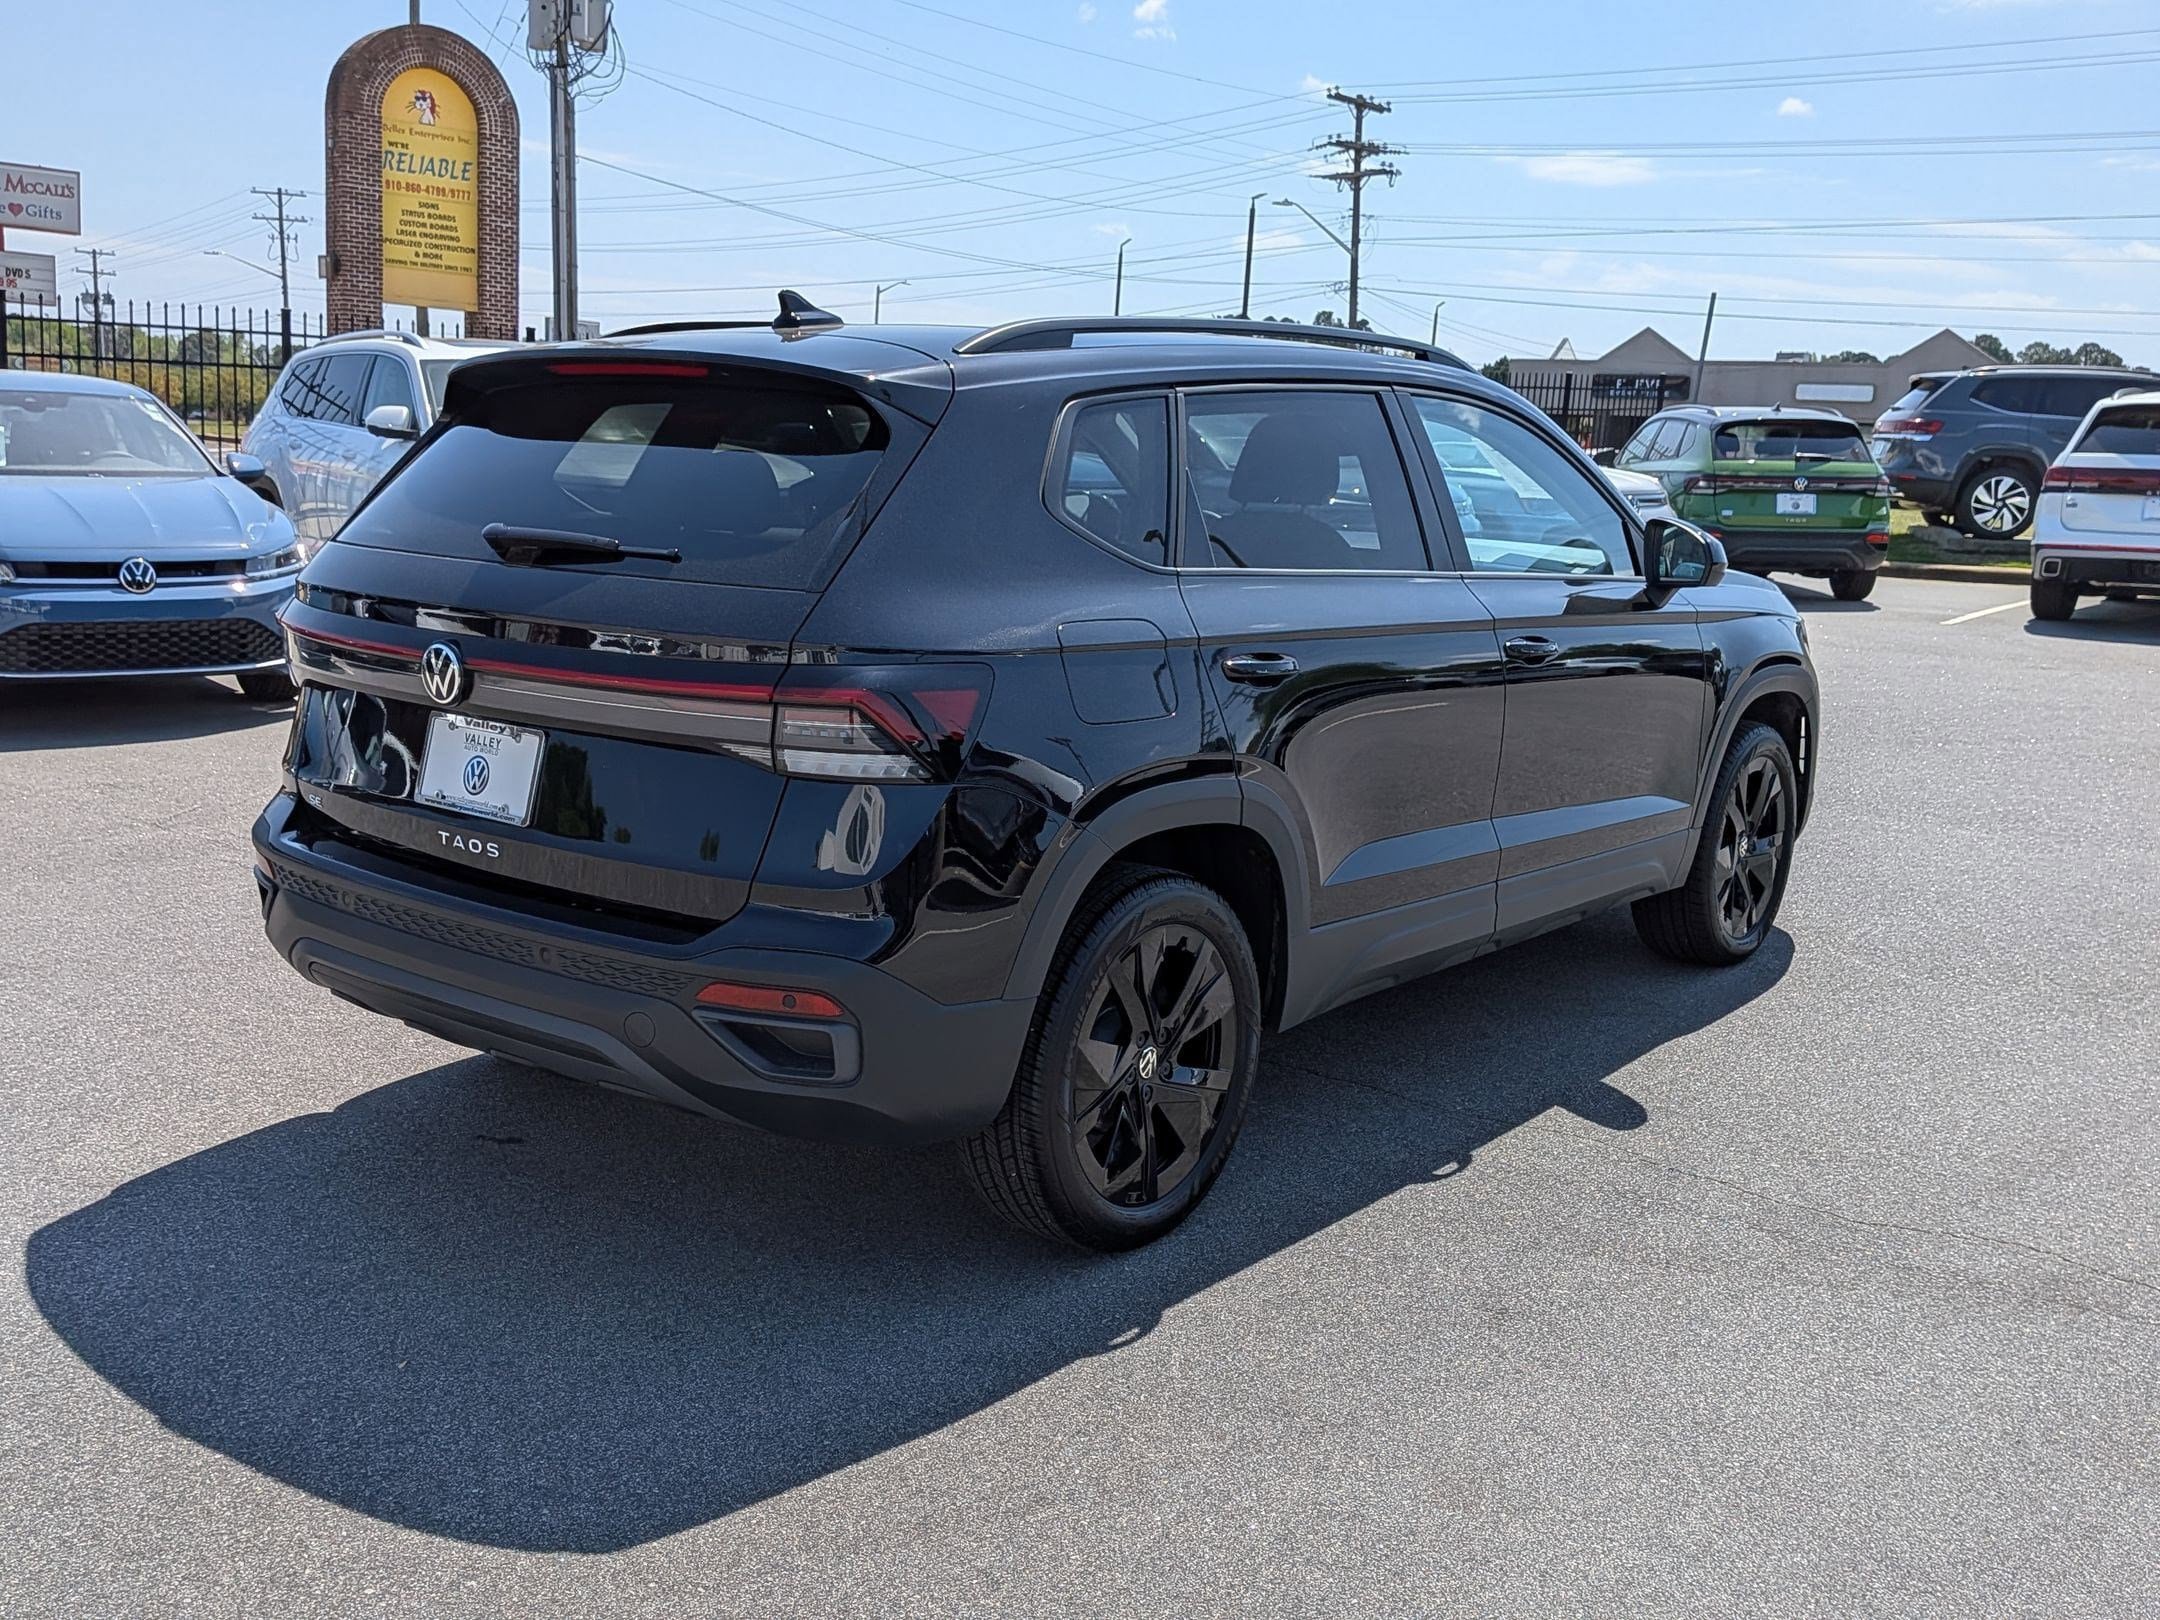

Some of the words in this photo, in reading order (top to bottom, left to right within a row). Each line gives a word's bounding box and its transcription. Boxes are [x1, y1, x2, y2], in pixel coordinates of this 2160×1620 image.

[409, 128, 455, 142] Enterprises
[383, 150, 473, 181] RELIABLE
[25, 204, 62, 220] Gifts
[418, 201, 439, 210] SIGNS
[401, 209, 425, 219] STATUS
[427, 213, 456, 222] BOARDS
[399, 219, 428, 229] CUSTOM
[429, 223, 459, 233] BOARDS
[396, 228, 417, 238] LASER
[419, 231, 461, 243] ENGRAVING
[383, 237, 422, 248] PECIALIZED
[424, 241, 475, 254] CONSTRUCTION
[422, 252, 443, 260] MORE
[464, 718, 507, 734] Valley
[465, 732, 502, 749] VALLEY
[464, 745, 479, 753] AUTO
[480, 747, 499, 757] WORLD
[308, 793, 323, 809] SE
[424, 797, 516, 822] www.valleyautoworld.com
[437, 830, 500, 858] TAOS
